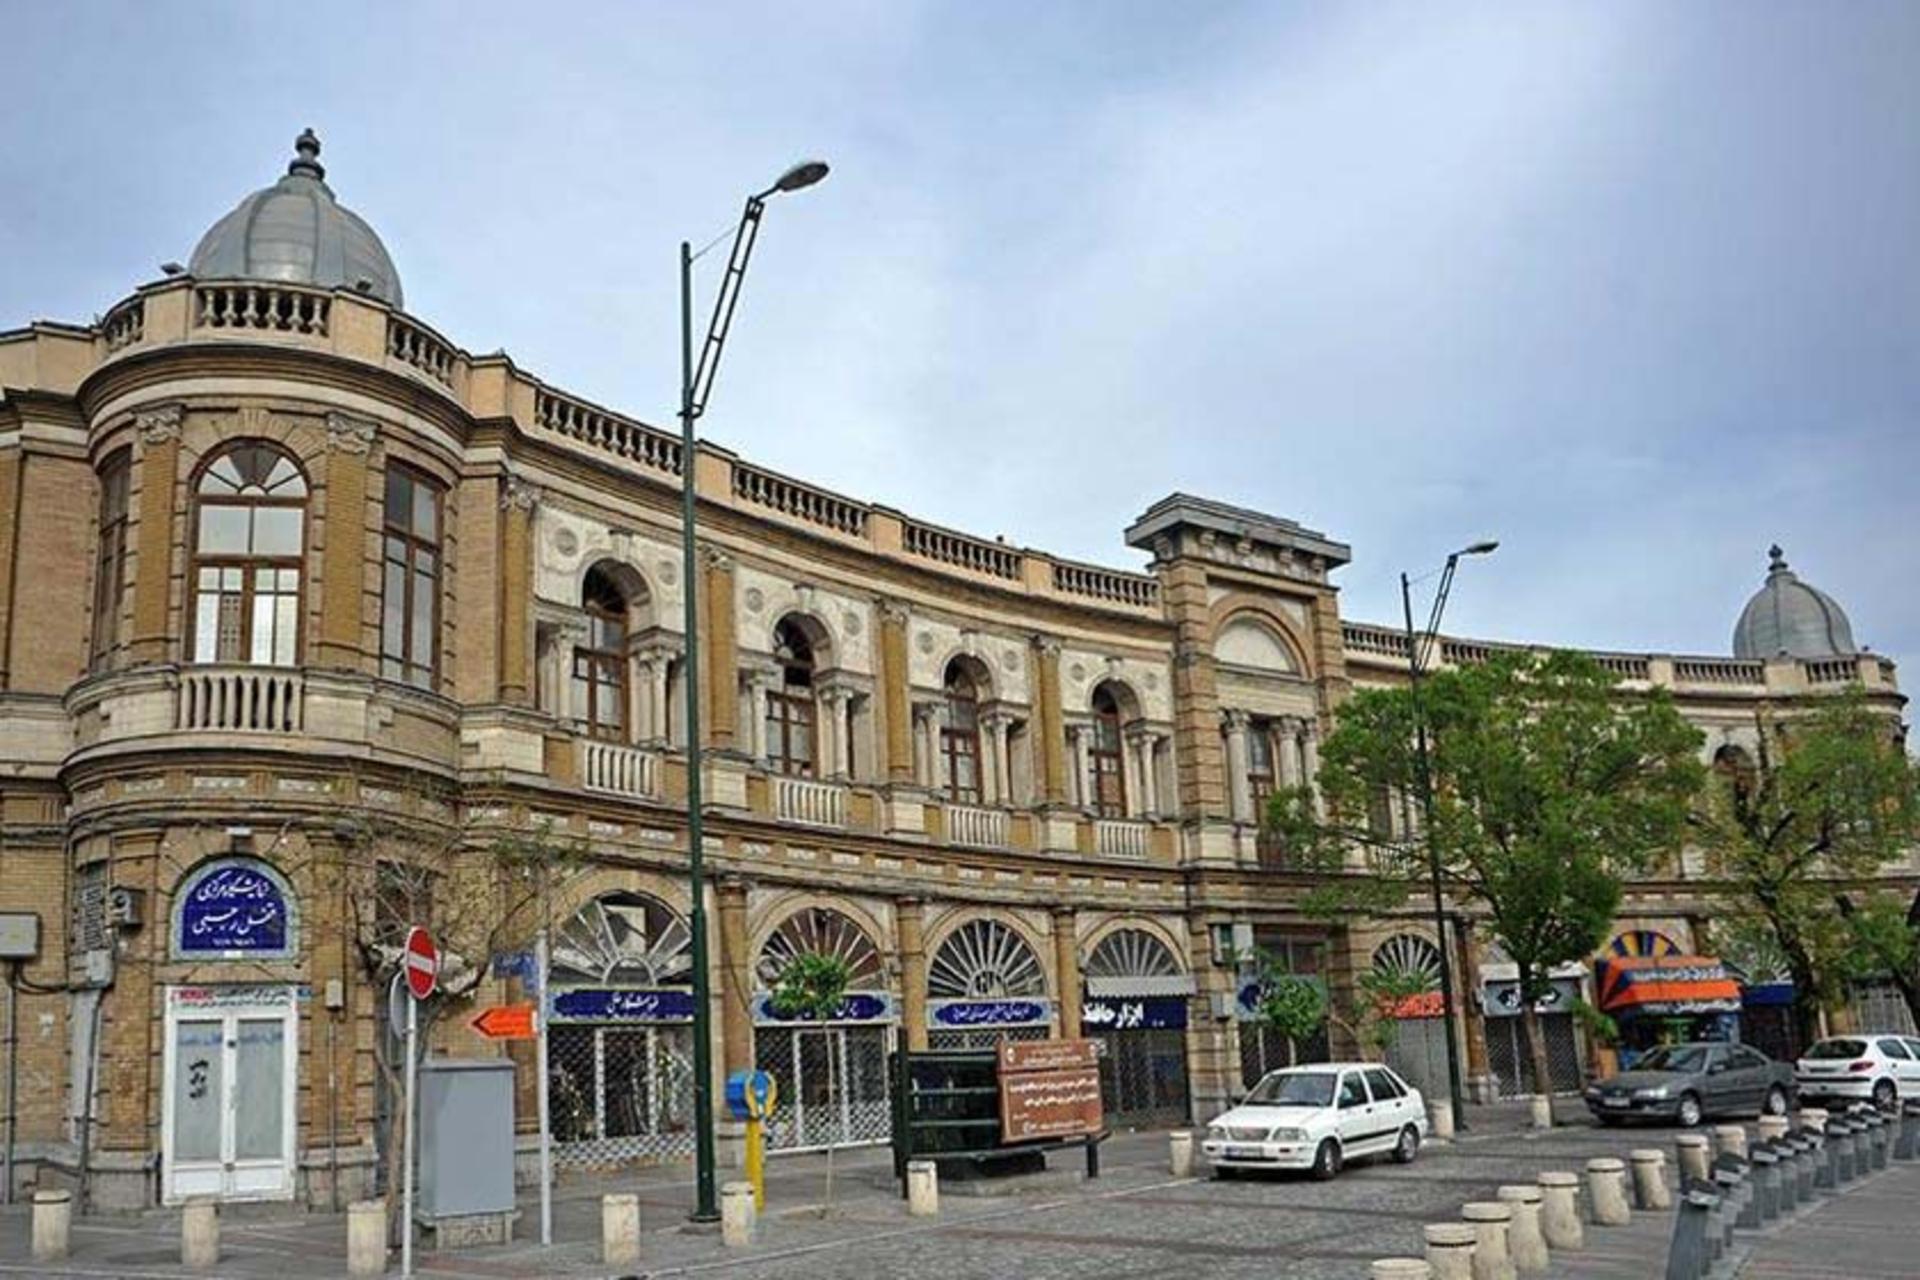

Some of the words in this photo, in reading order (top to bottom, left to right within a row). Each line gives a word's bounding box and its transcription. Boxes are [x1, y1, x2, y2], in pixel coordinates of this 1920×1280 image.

[226, 874, 270, 898] نمایشگاه
[237, 902, 276, 935] قفل
[1115, 1002, 1144, 1029] ابزار
